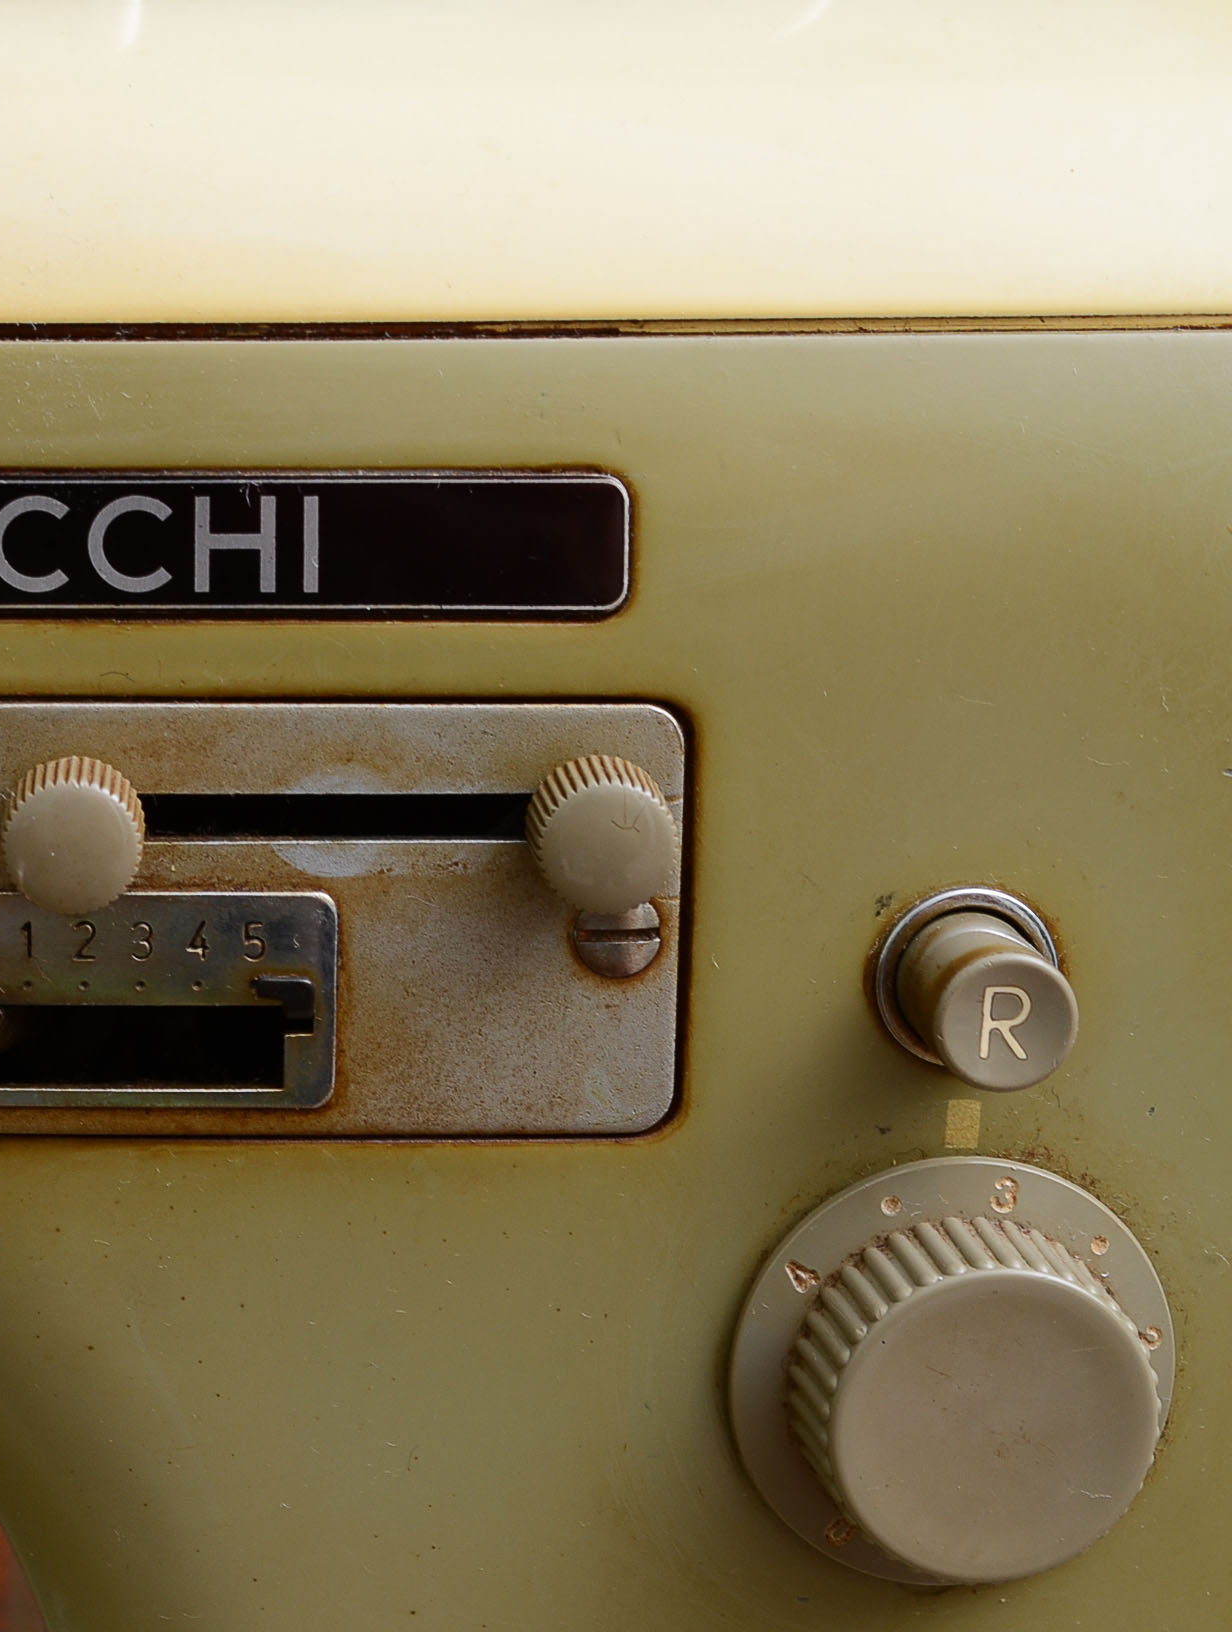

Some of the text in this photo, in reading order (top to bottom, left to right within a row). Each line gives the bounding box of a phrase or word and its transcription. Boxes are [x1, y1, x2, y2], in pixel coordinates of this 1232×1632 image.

[20, 920, 34, 959] 1
[72, 920, 97, 962] 2
[130, 921, 154, 962] 3
[185, 920, 210, 962] 4
[241, 921, 267, 962] 5
[979, 985, 1032, 1060] R
[990, 1175, 1020, 1214] 3
[784, 1259, 821, 1294] 4
